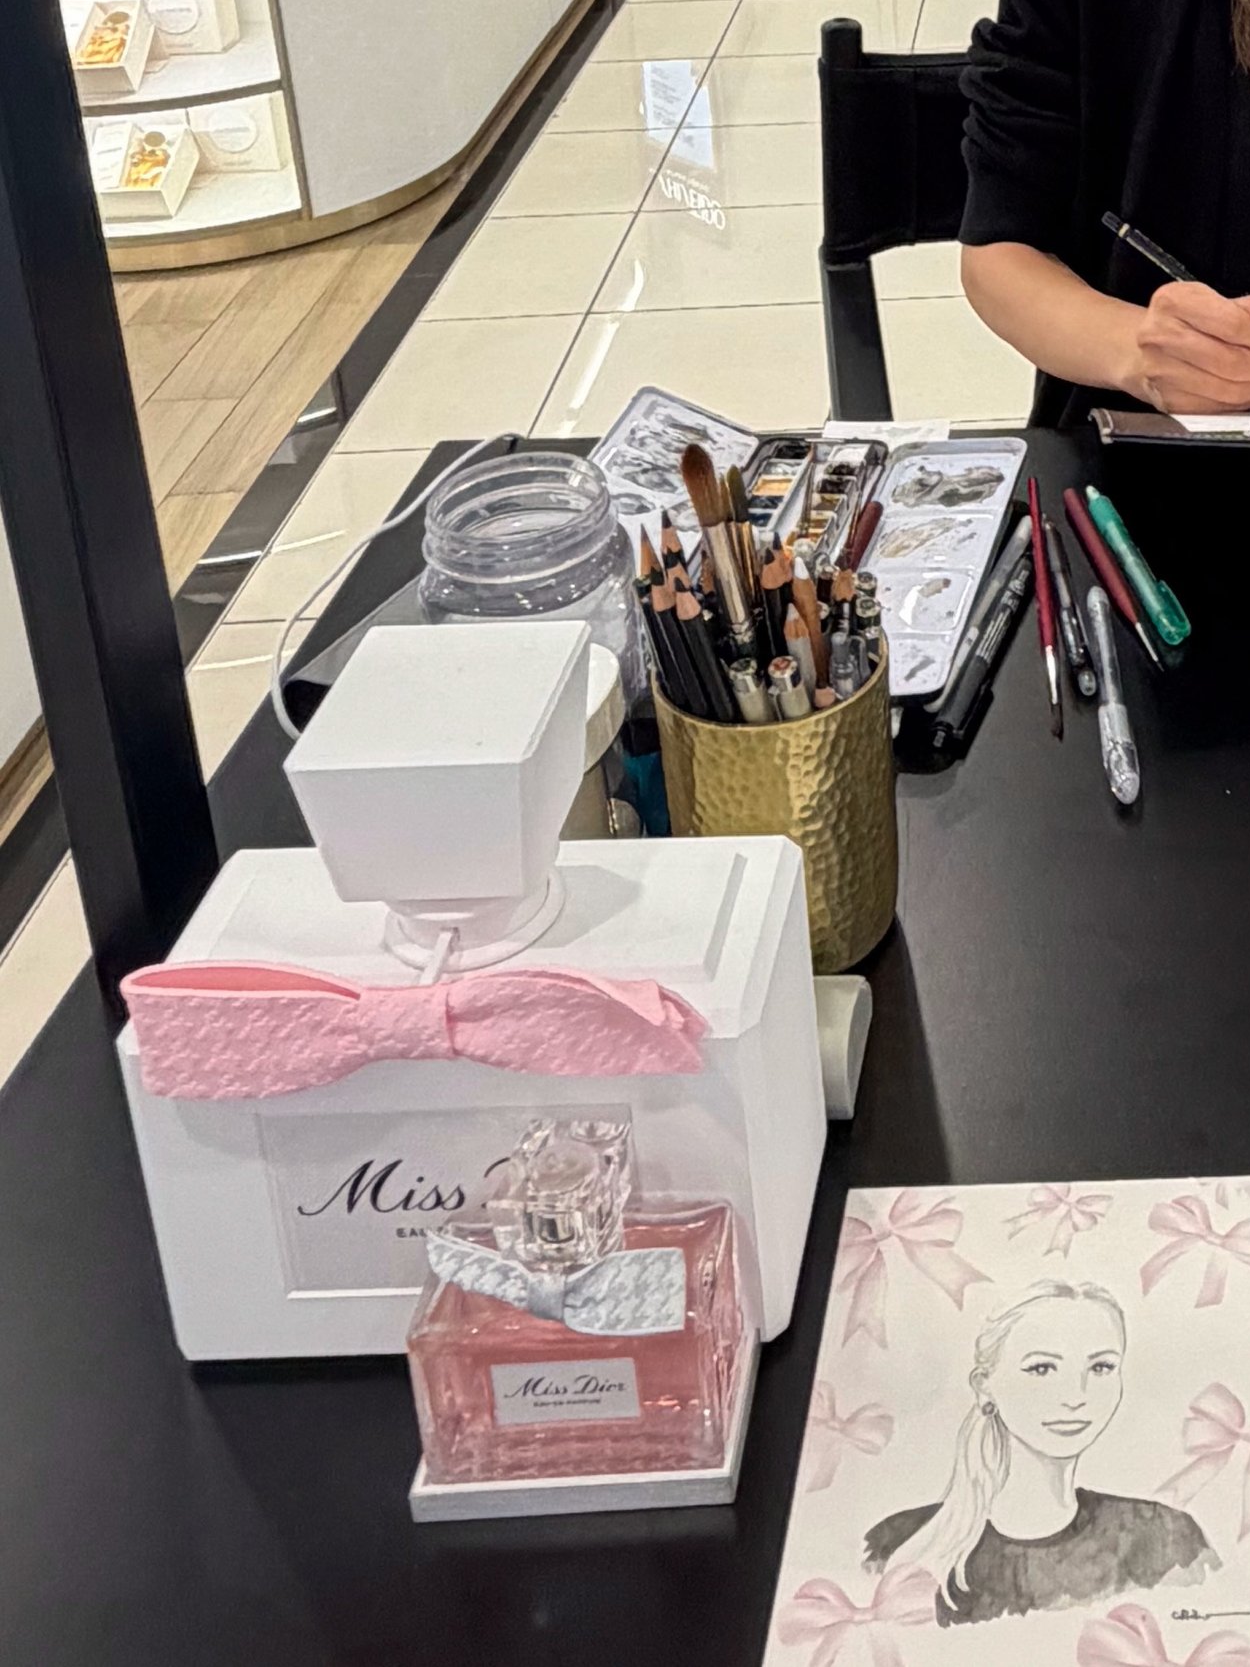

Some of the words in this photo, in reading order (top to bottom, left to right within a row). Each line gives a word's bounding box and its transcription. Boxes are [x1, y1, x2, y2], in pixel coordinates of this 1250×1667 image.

[297, 1159, 466, 1216] Miss
[504, 1376, 569, 1399] Miss
[572, 1374, 628, 1396] Dior
